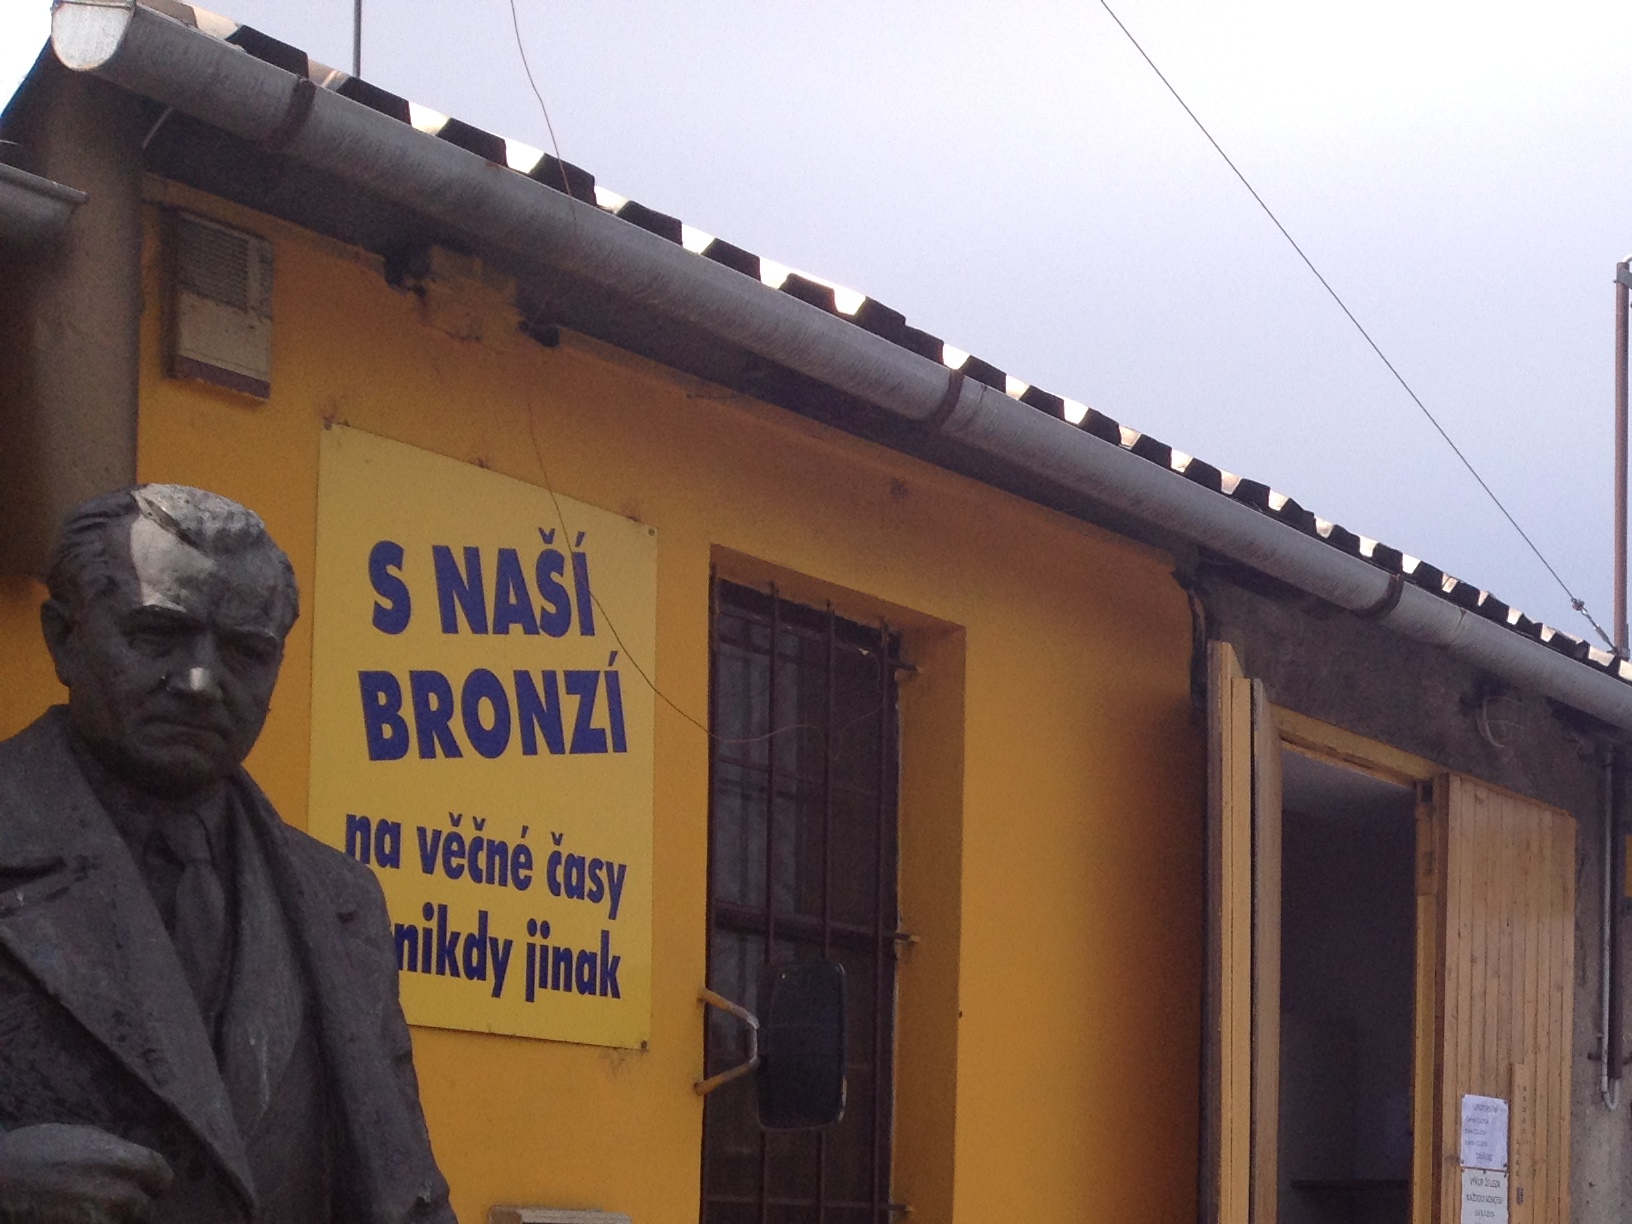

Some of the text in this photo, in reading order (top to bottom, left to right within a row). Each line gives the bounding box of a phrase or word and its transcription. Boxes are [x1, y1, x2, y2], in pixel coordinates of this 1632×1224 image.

[368, 527, 597, 639] S NAŠÍ
[357, 650, 629, 762] BRONZÍ
[344, 811, 628, 921] na věčné časy
[394, 901, 622, 1003] nikdy jinak
